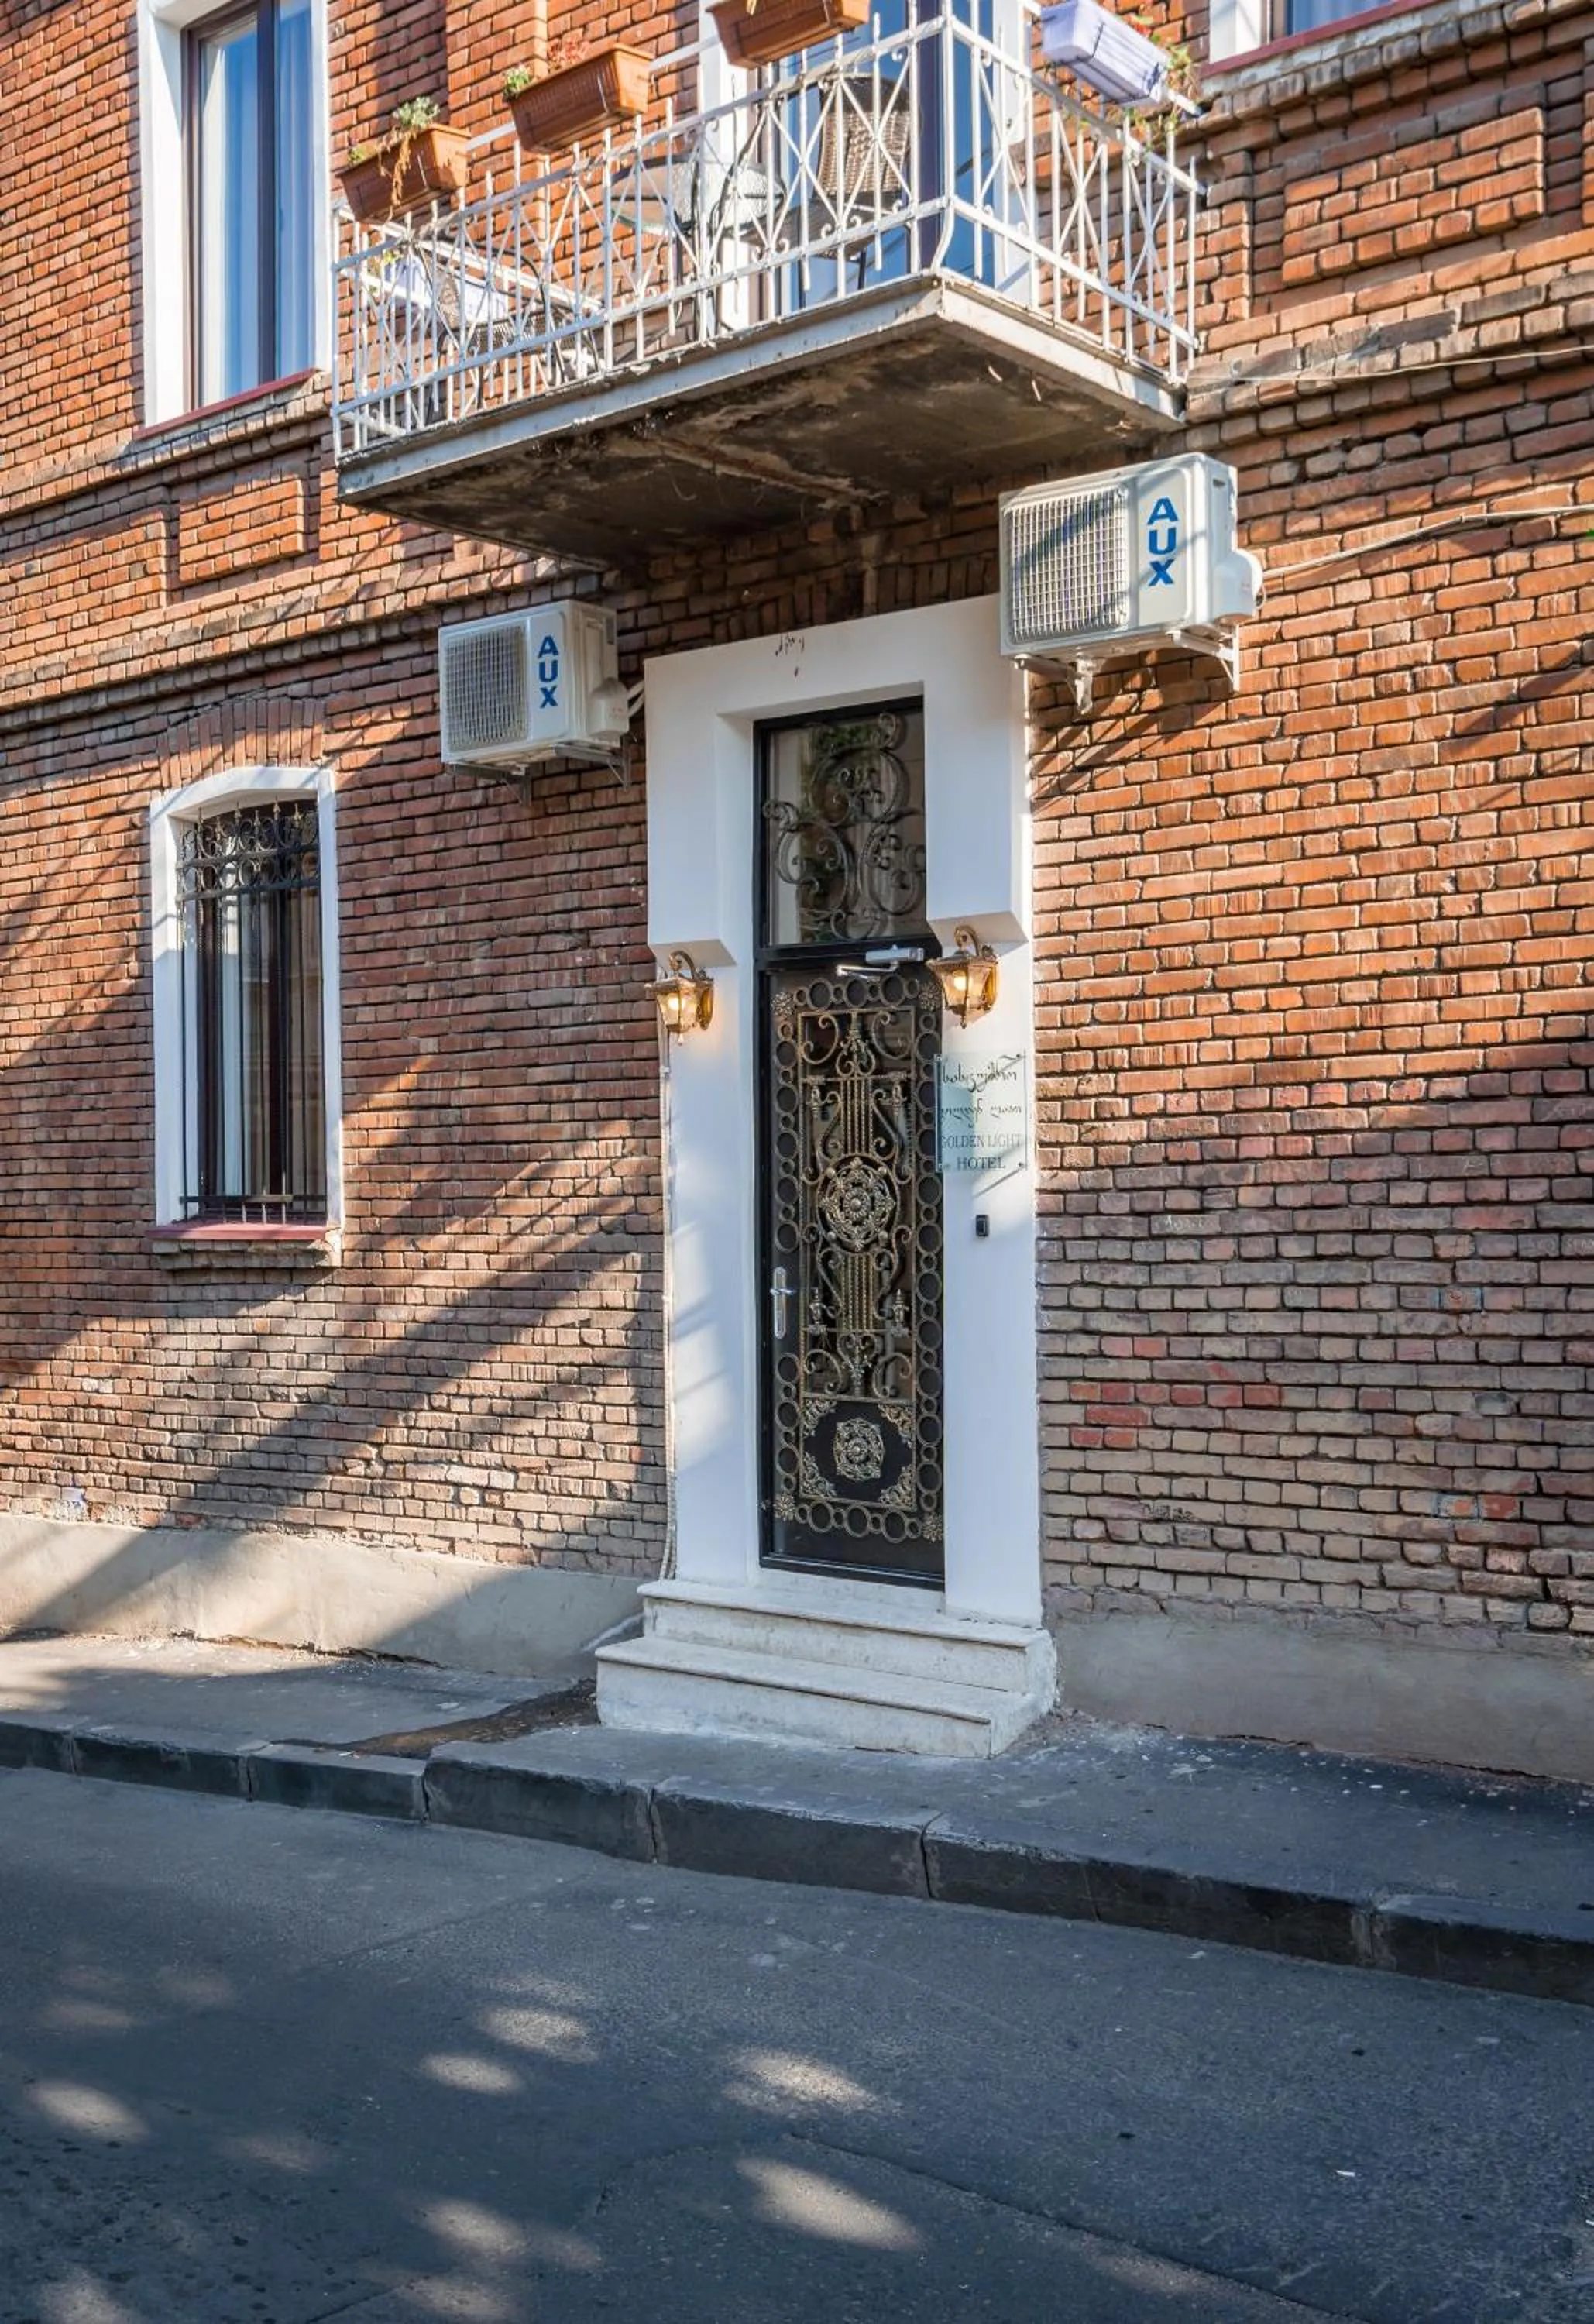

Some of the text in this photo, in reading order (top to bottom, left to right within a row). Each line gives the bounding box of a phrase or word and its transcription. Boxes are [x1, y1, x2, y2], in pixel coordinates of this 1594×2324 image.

[1146, 497, 1179, 587] AUX
[538, 634, 559, 710] AUX
[987, 1133, 1022, 1147] LIGHT
[957, 1157, 1006, 1170] HOTEL
